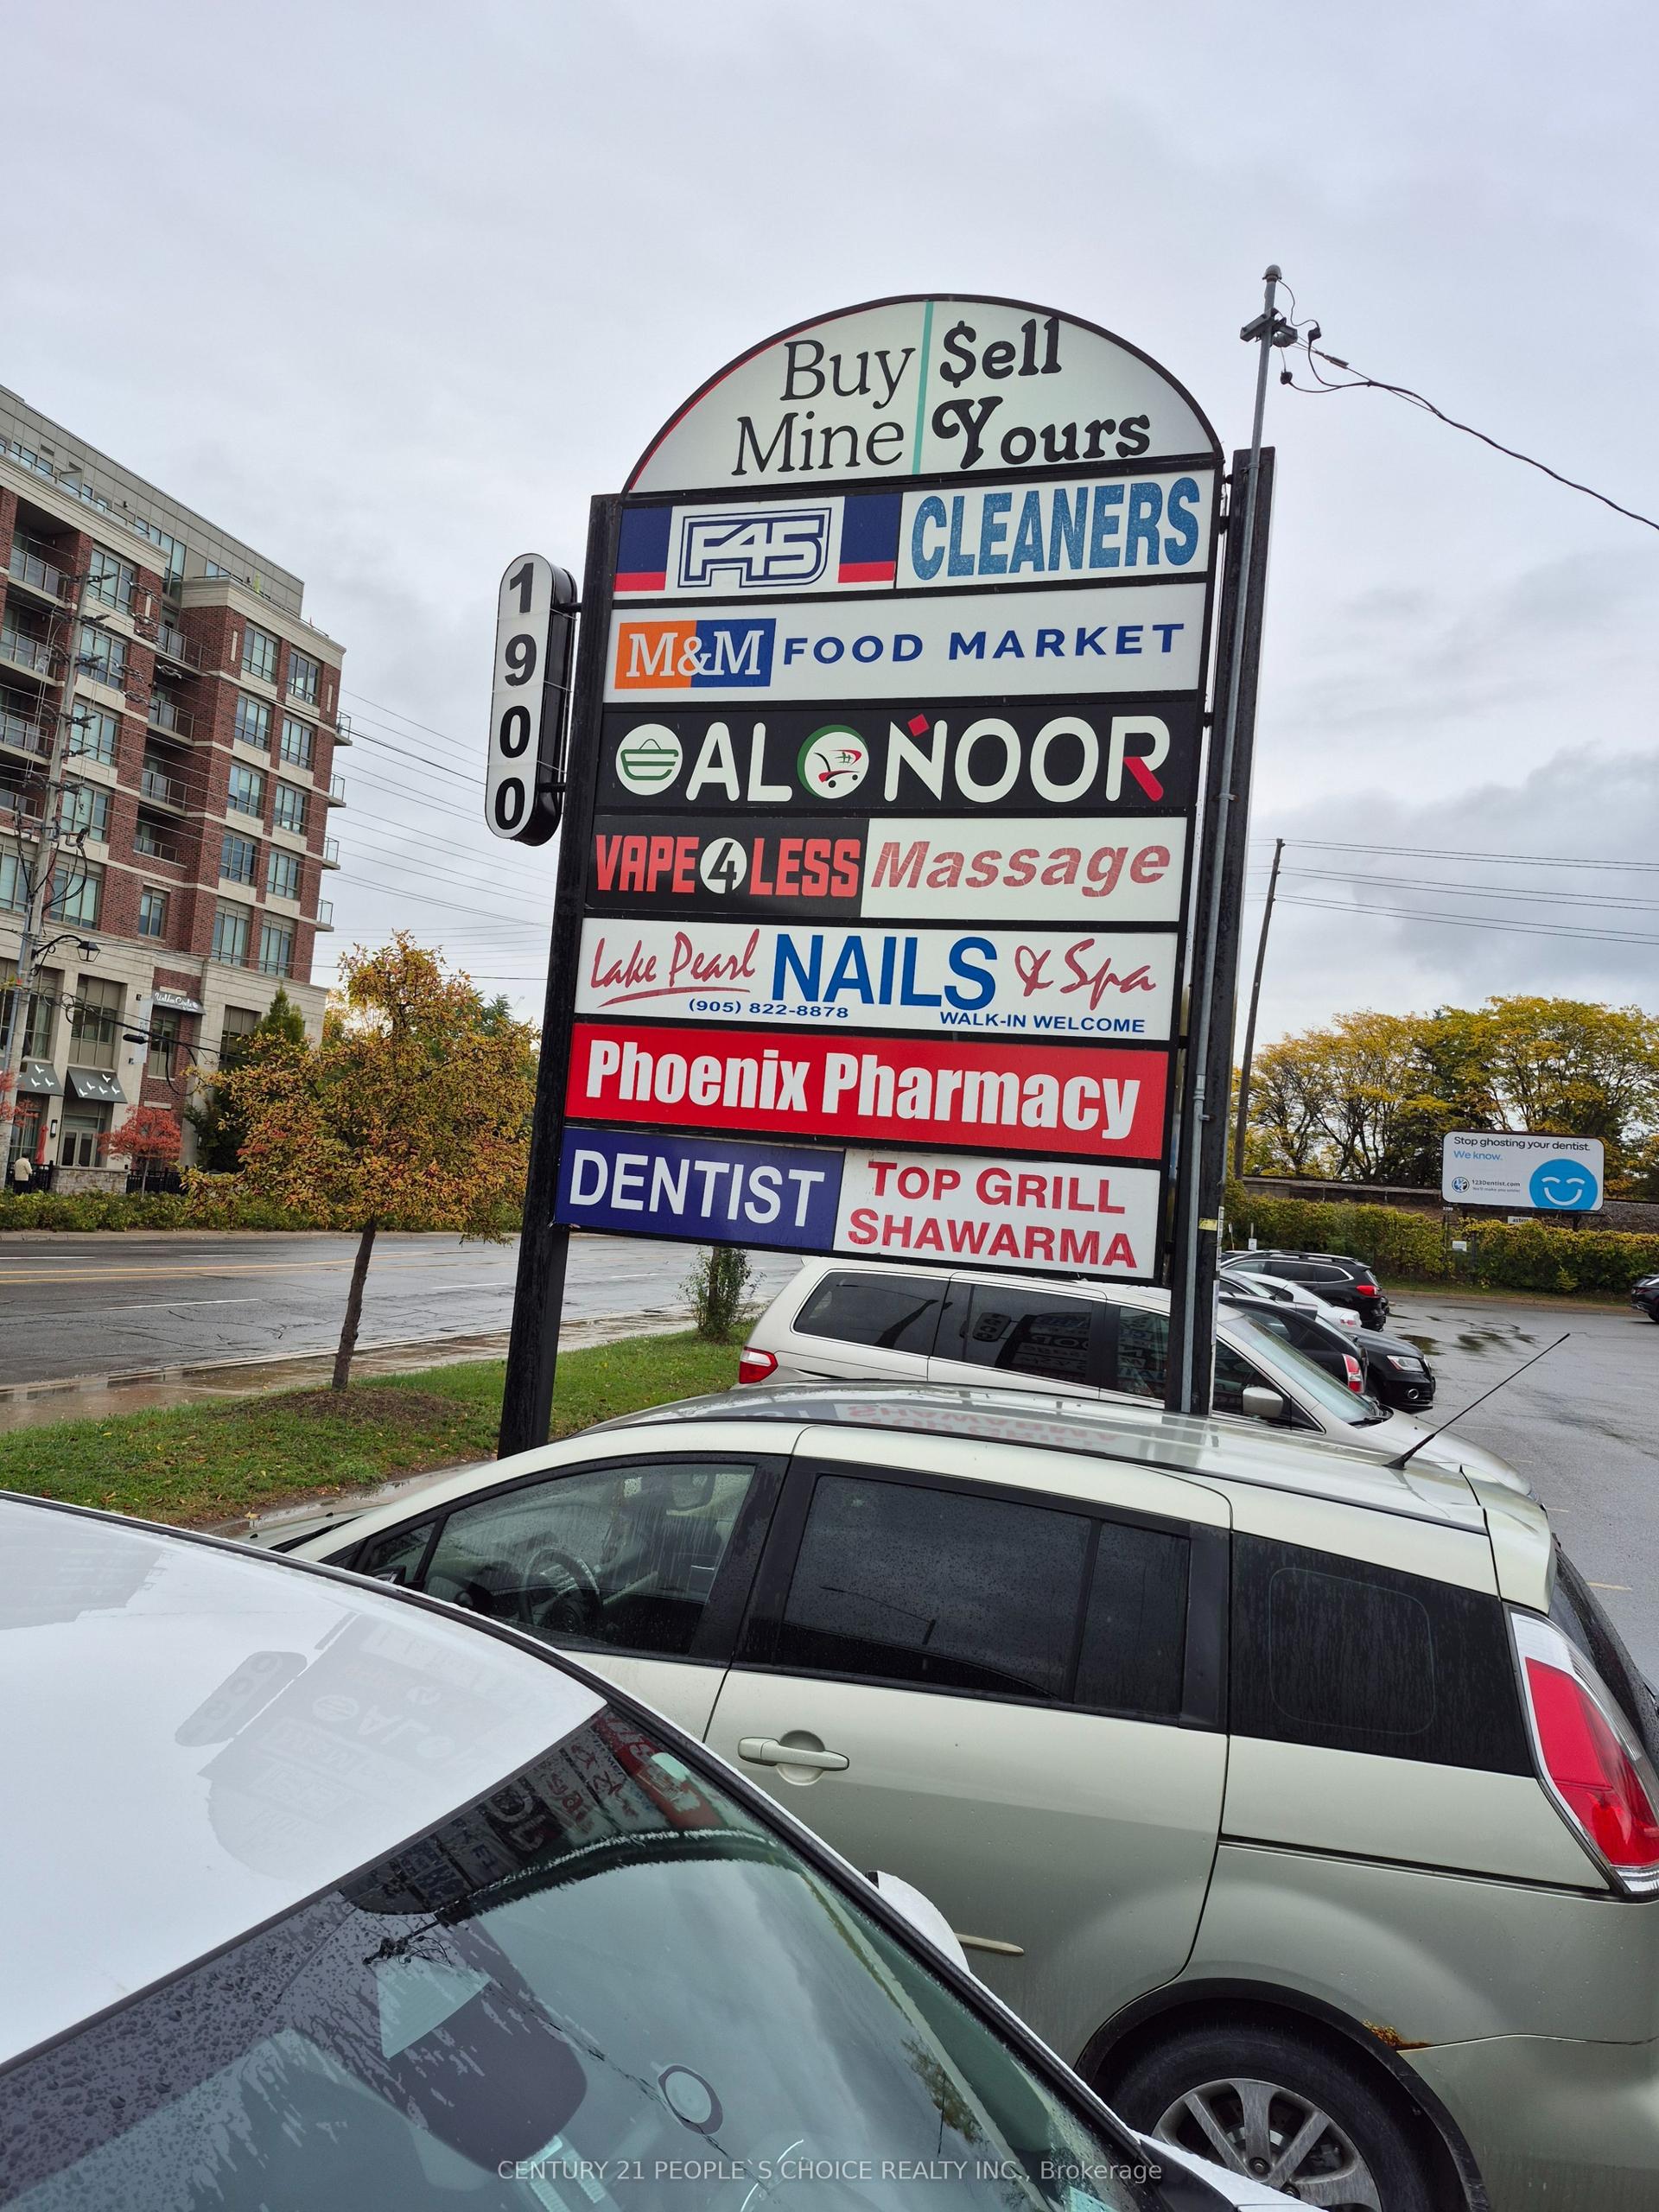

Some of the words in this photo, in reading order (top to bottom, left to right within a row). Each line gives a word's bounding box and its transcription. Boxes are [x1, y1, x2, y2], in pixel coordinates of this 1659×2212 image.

[780, 339, 917, 409] Buy
[731, 411, 904, 477] Mine
[931, 396, 1151, 469] Yours
[680, 510, 830, 587] F45
[910, 476, 1200, 581] CLEANERS
[626, 629, 765, 678] M&M
[783, 633, 924, 665] FOOD
[949, 623, 1185, 662] MARKET
[495, 562, 537, 830] 1900
[685, 721, 793, 803] AL
[884, 714, 1172, 804] NOOR
[595, 834, 698, 898] VAPE
[749, 837, 861, 898] LESS
[870, 841, 1171, 898] Massage
[590, 937, 658, 988] Lake
[668, 928, 760, 987] Pearl
[772, 933, 998, 1011] NAILS
[1058, 938, 1156, 1011] Spa
[688, 997, 742, 1016] (905)
[748, 1001, 849, 1020] 822-8878
[939, 1011, 1028, 1028] WALK-IN
[1033, 1015, 1145, 1033] WELCOME
[586, 1039, 811, 1113] Phoenix
[821, 1052, 1141, 1141] Pharmacy
[1453, 1136, 1478, 1147] Stop
[1479, 1137, 1526, 1149] ghosting
[1527, 1141, 1550, 1151] your
[1552, 1141, 1591, 1151] dentist.
[1453, 1150, 1471, 1160] We
[1472, 1151, 1503, 1161] know.
[569, 1149, 825, 1228] DENTIST
[868, 1160, 962, 1201] TOP
[975, 1167, 1126, 1215] GRILL
[848, 1208, 1138, 1270] SHAWARMA
